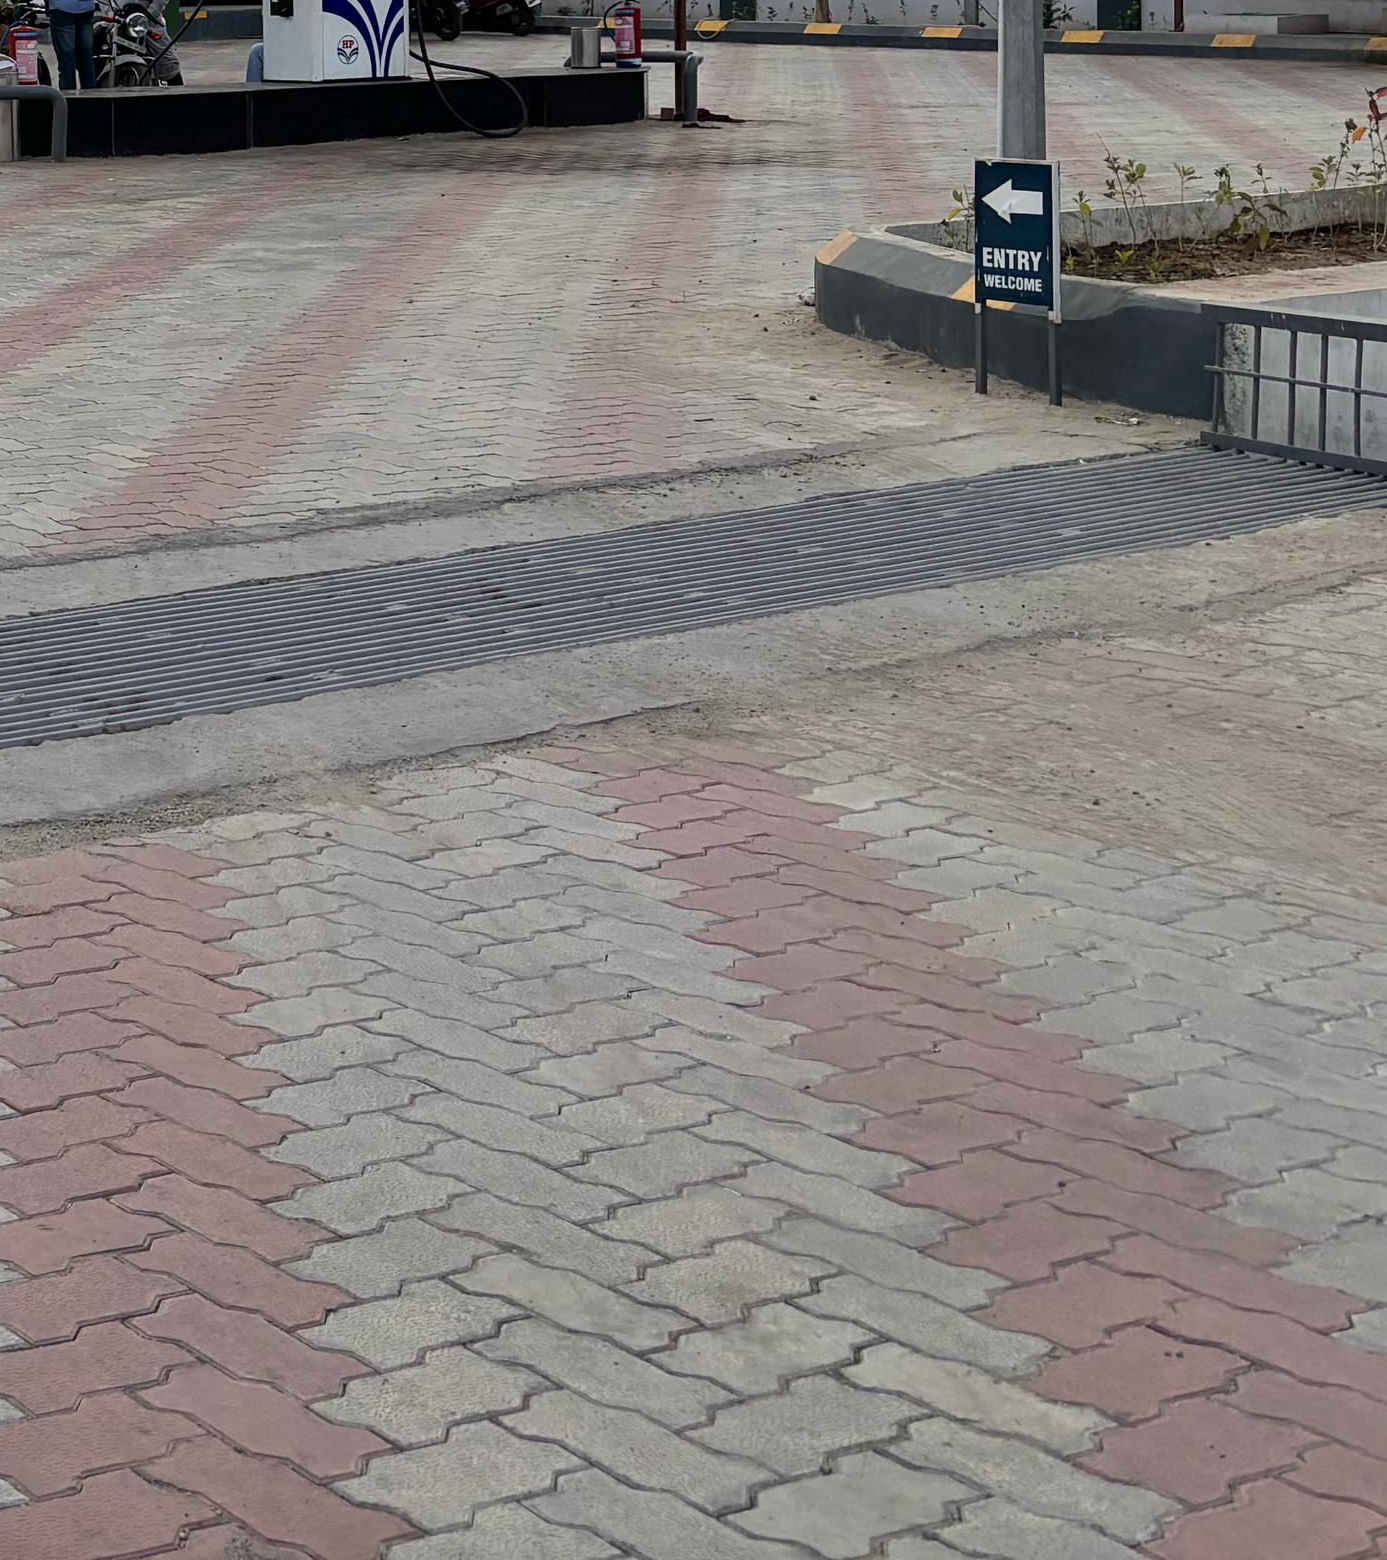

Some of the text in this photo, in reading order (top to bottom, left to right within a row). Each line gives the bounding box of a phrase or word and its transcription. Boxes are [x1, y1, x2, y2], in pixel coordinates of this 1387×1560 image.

[342, 40, 355, 49] HP
[982, 246, 1043, 272] ENTRY
[983, 273, 1043, 293] WELCOME
